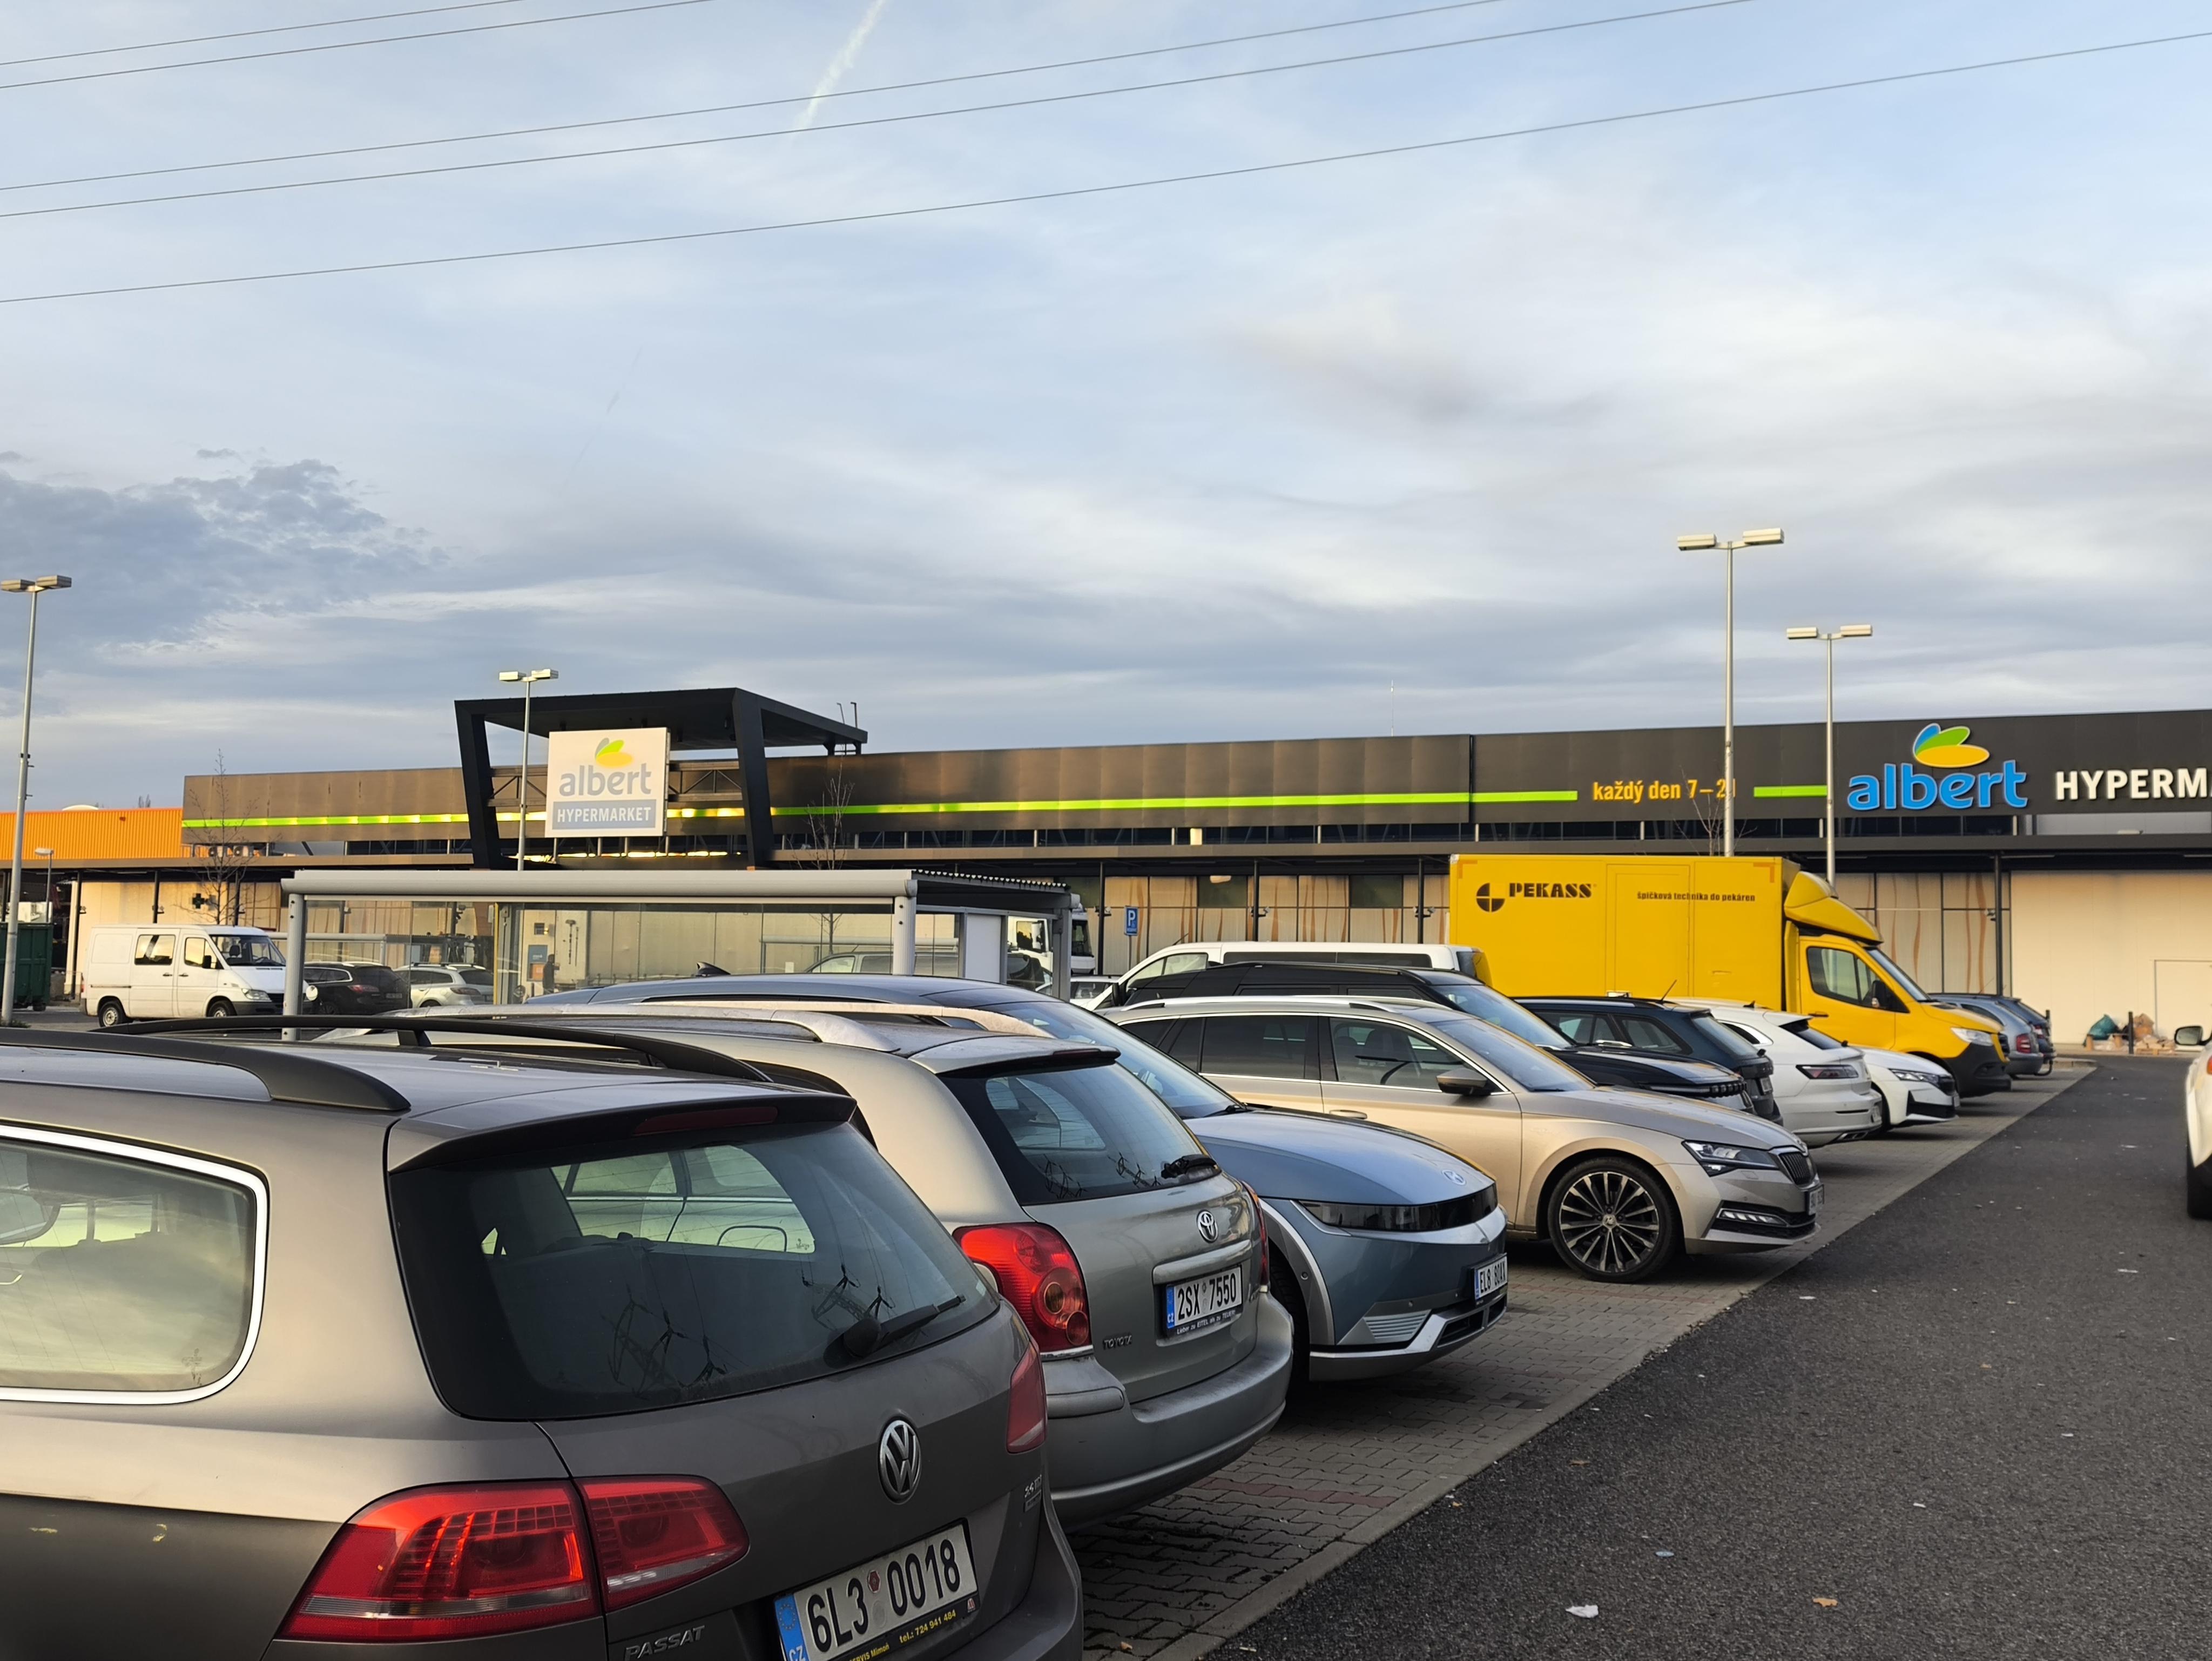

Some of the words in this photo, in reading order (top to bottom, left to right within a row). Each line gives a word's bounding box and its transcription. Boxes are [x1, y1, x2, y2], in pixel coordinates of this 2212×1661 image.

[559, 763, 652, 796] albert
[1593, 780, 1644, 804] každý
[1649, 780, 1681, 799] den
[1846, 760, 2028, 810] albert
[2056, 767, 2212, 800] HYPERM
[557, 807, 651, 823] HYPERMARKET
[1509, 883, 1593, 898] PEKASS
[1637, 891, 1672, 900] špičková
[1674, 892, 1709, 901] technika
[1710, 893, 1720, 901] do
[1722, 893, 1756, 902] pekáren
[1128, 910, 1136, 927] P
[1167, 1313, 1175, 1324] CZ
[1178, 1283, 1200, 1321] 2SX
[1209, 1273, 1237, 1311] 7550
[1103, 1334, 1132, 1349] TOYOTA
[788, 1644, 807, 1661] CZ
[807, 1577, 869, 1653] 6L3
[887, 1538, 961, 1617] 0018
[624, 1624, 705, 1661] PASSAT
[899, 1631, 914, 1644] tel.:
[915, 1623, 928, 1636] 724
[929, 1616, 942, 1629] 941
[943, 1609, 956, 1622] 484
